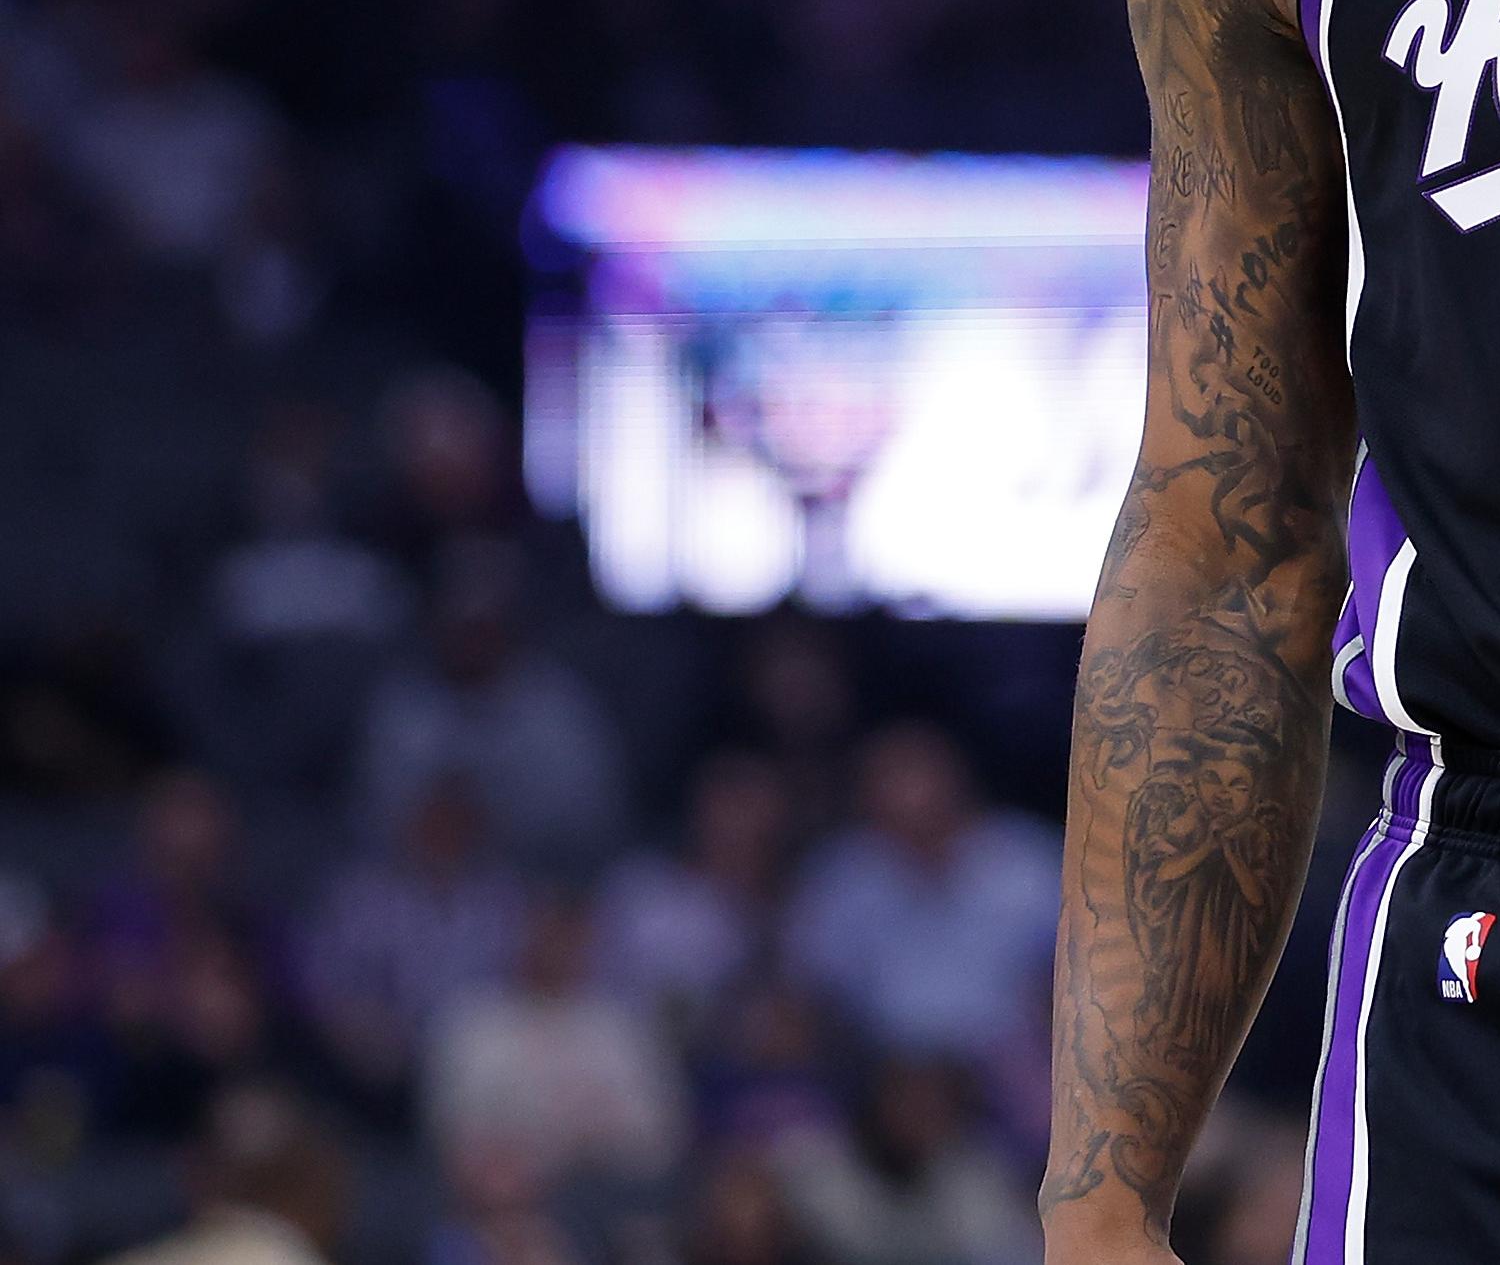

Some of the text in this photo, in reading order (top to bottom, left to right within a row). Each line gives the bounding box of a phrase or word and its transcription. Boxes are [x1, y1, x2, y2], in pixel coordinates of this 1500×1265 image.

[1251, 345, 1281, 380] TOO
[1246, 365, 1283, 407] LOUD
[1441, 979, 1463, 999] NBA
